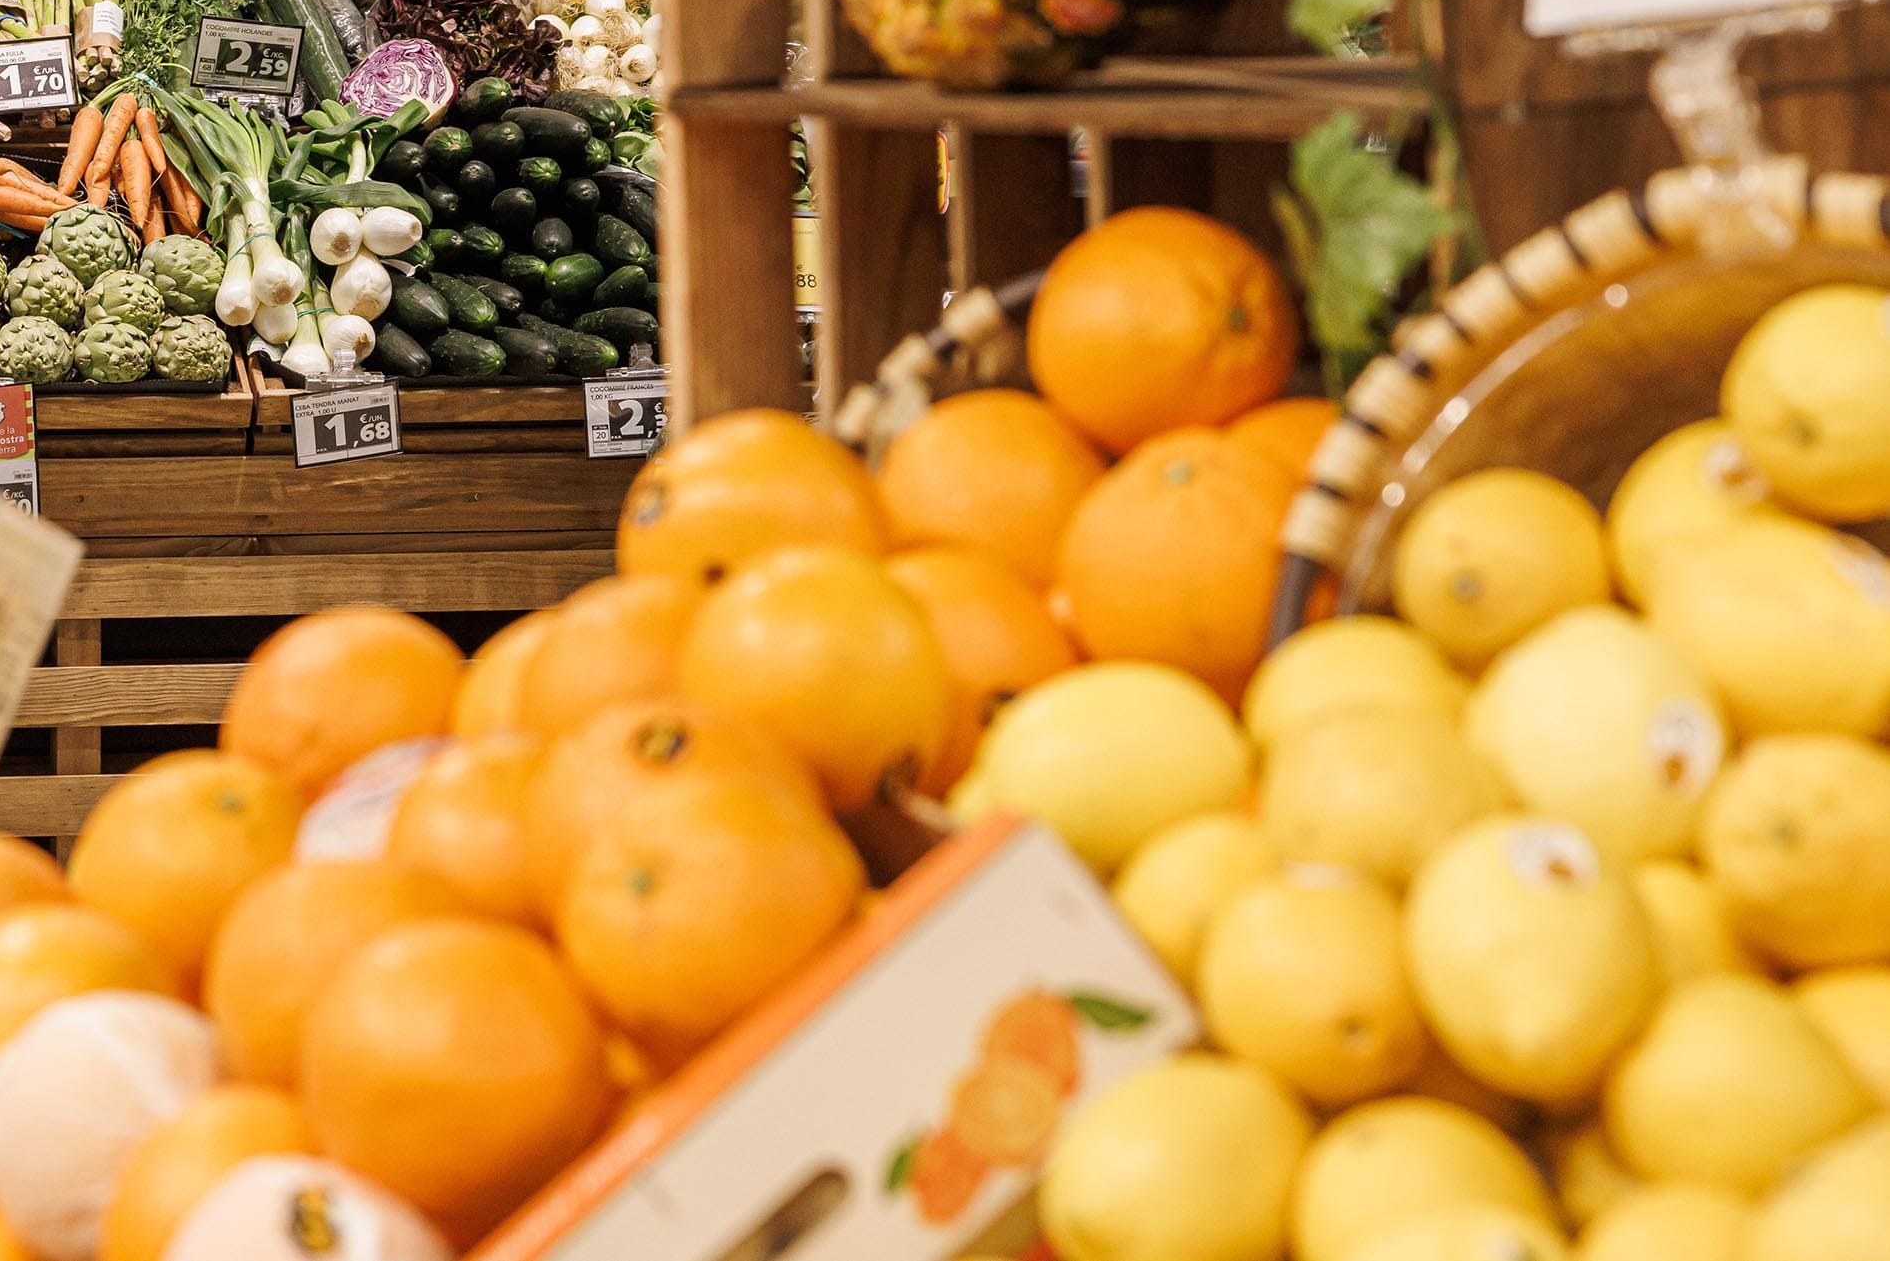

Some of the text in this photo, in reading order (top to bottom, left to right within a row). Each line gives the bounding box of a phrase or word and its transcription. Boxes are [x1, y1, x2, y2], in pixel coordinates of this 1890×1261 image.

[225, 40, 289, 77] 2,59
[0, 64, 64, 97] 1,70
[294, 396, 359, 412] CEBA TENDRA MANAT
[6, 427, 15, 435] la
[324, 413, 391, 448] 1,68
[596, 431, 606, 440] 20
